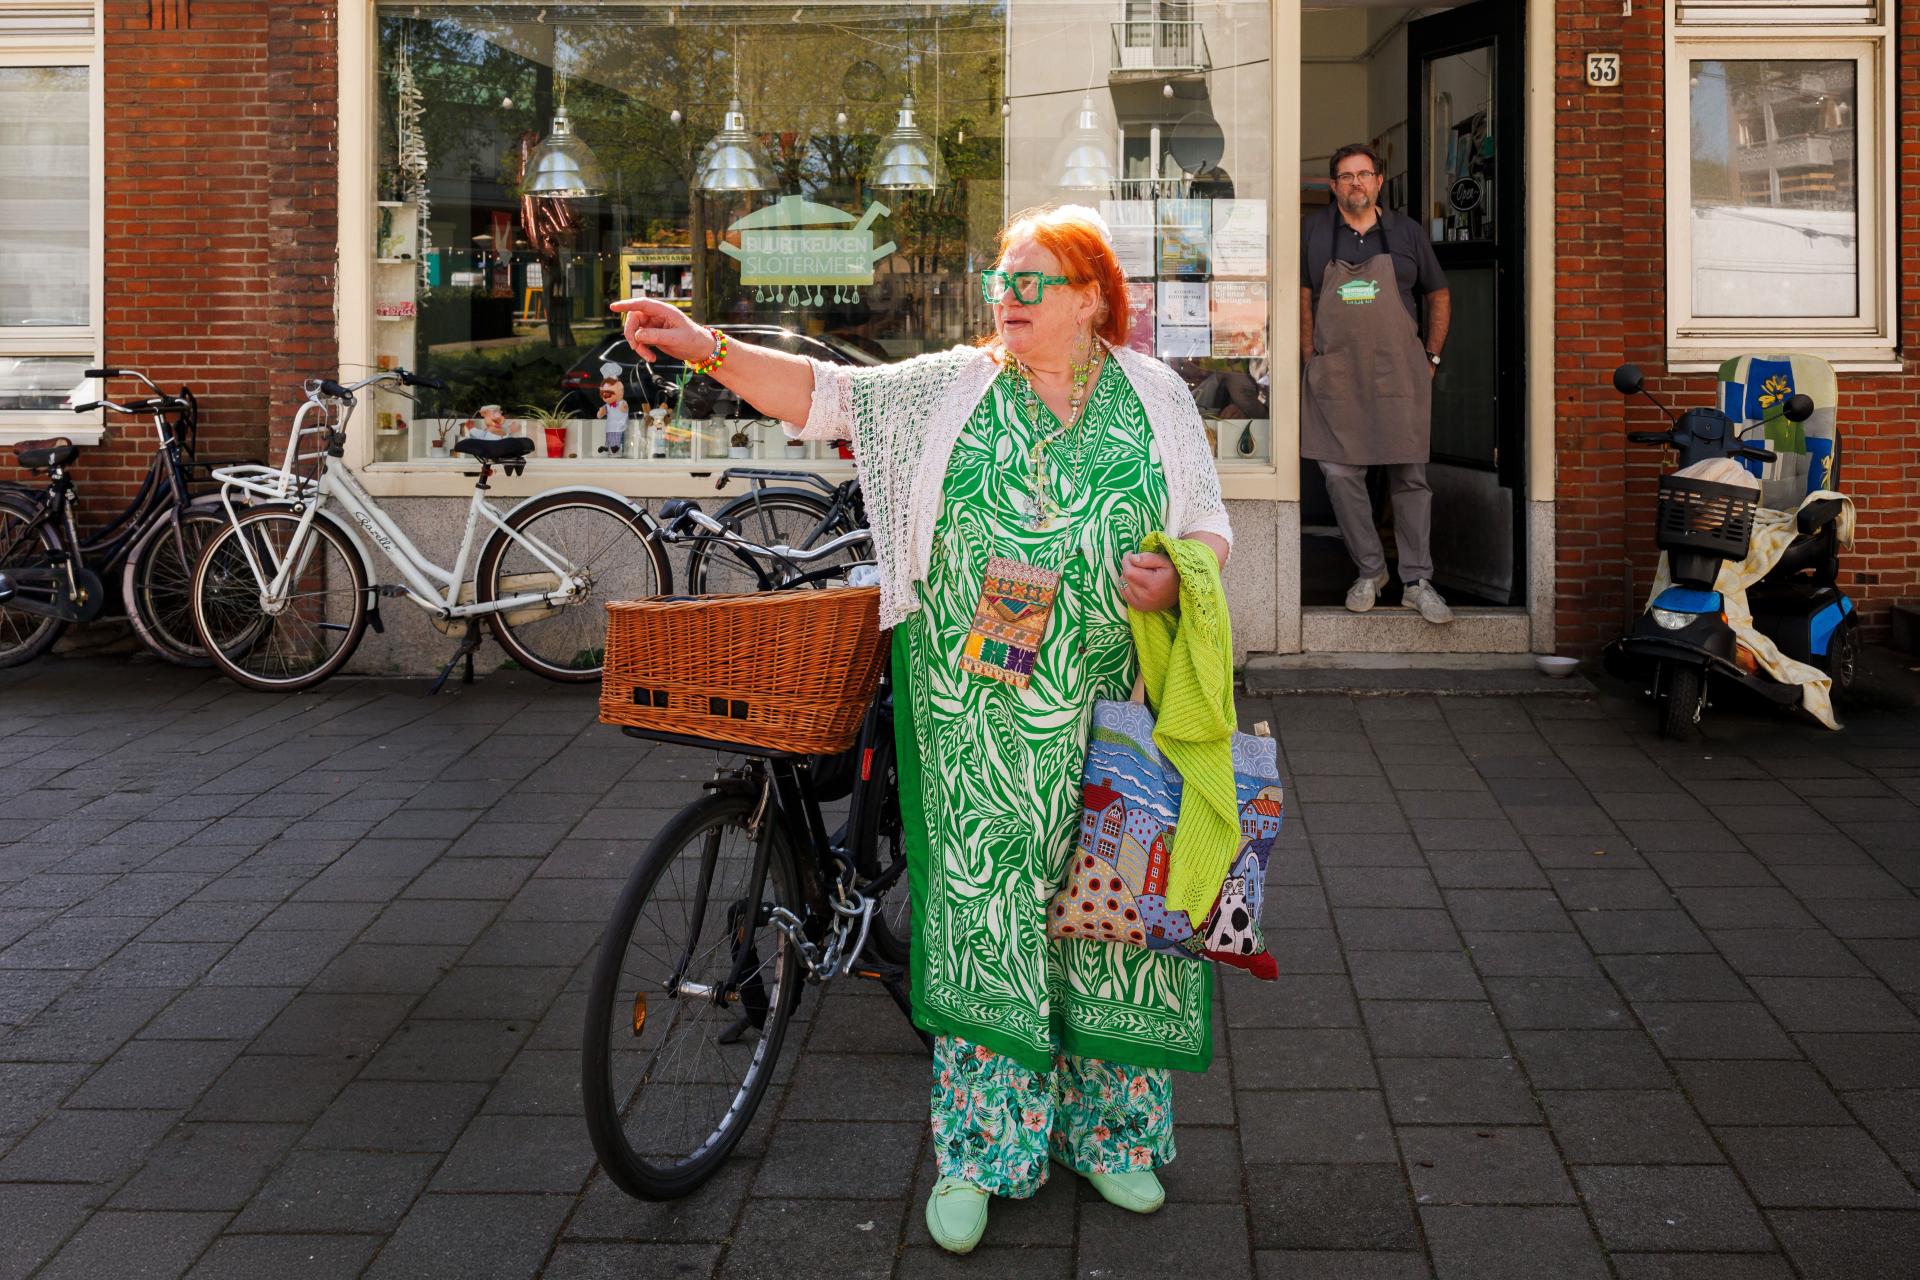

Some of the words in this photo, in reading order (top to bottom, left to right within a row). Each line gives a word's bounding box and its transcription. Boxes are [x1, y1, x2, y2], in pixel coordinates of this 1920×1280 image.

[1590, 57, 1616, 81] 33
[746, 237, 867, 253] BUURTKEUKEN
[746, 256, 867, 274] SLOTERMEER
[355, 511, 392, 552] Gazelle
